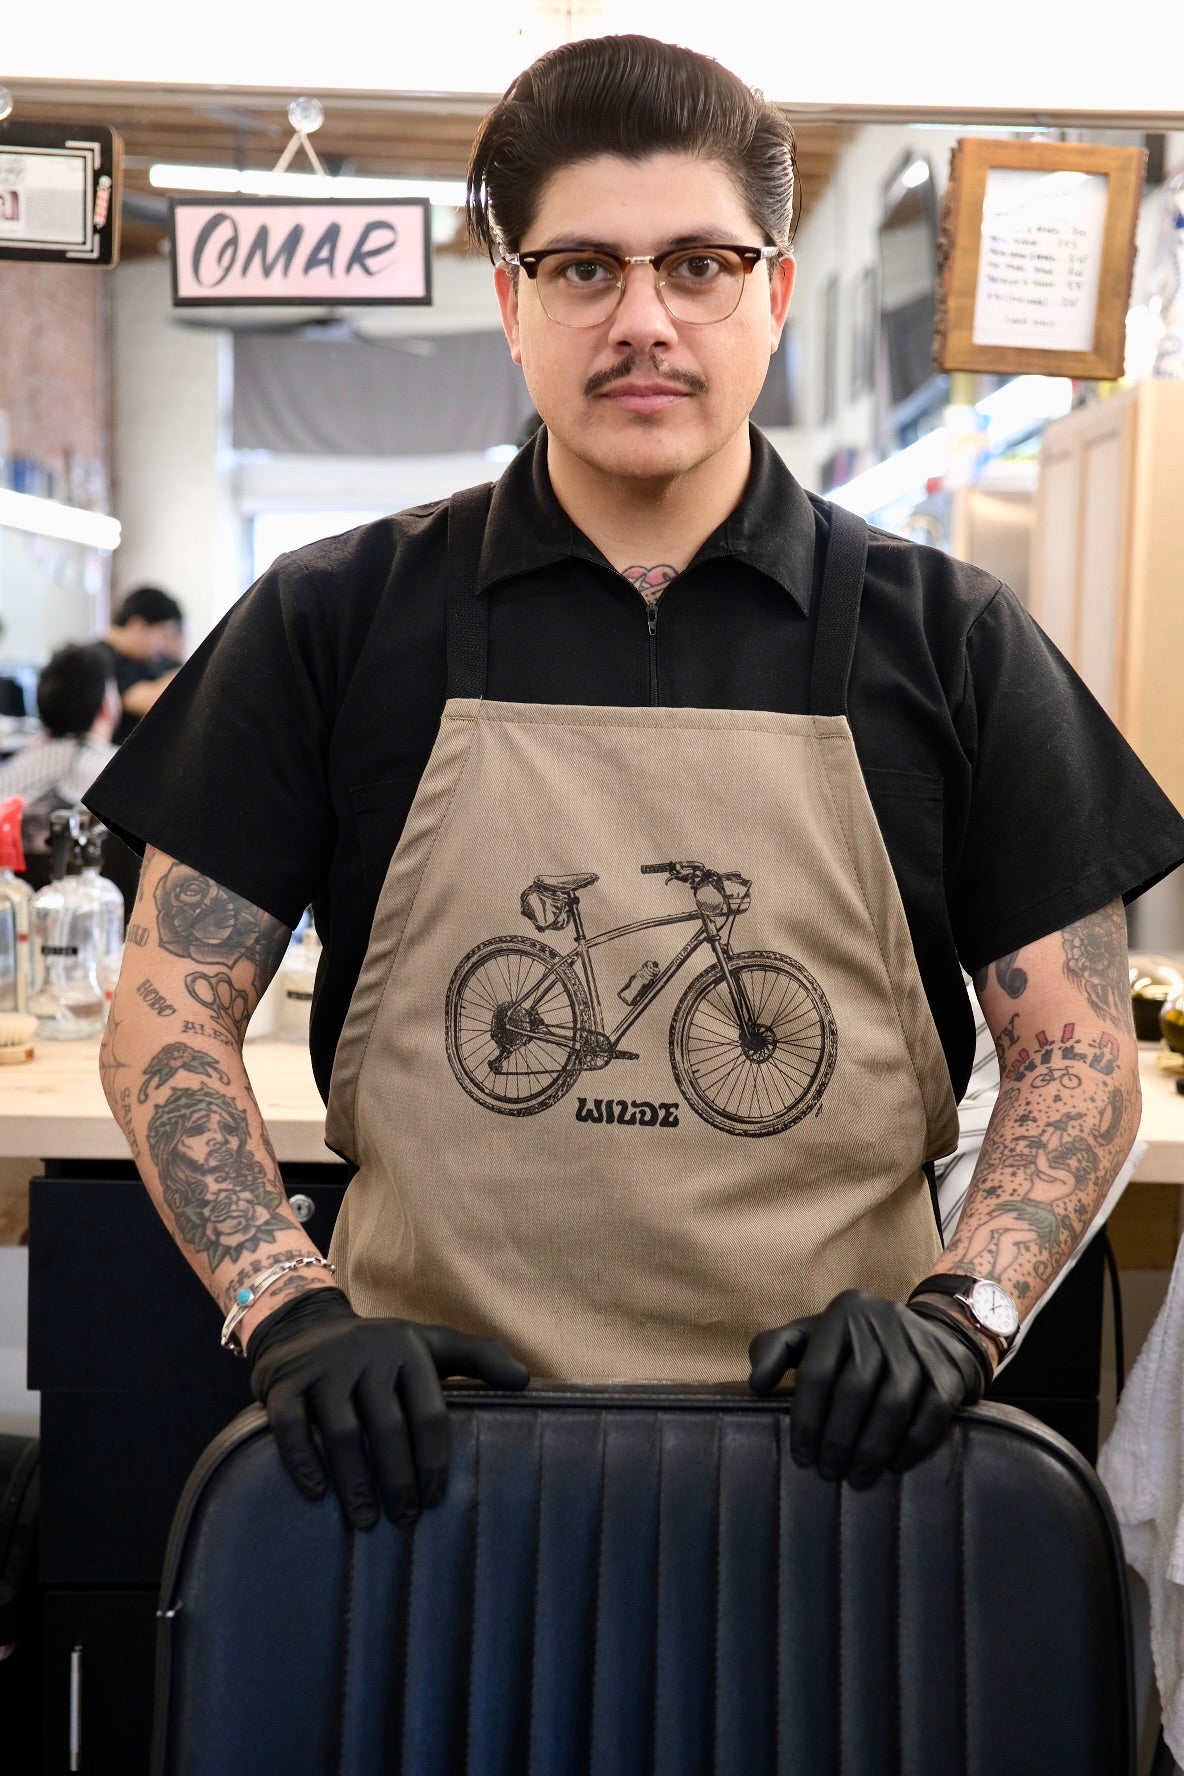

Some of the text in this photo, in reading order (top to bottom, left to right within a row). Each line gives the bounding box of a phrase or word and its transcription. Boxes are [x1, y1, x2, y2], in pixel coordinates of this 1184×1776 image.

[193, 212, 400, 288] OMAR
[136, 978, 177, 1017] HOBO
[575, 1097, 680, 1128] WILDE
